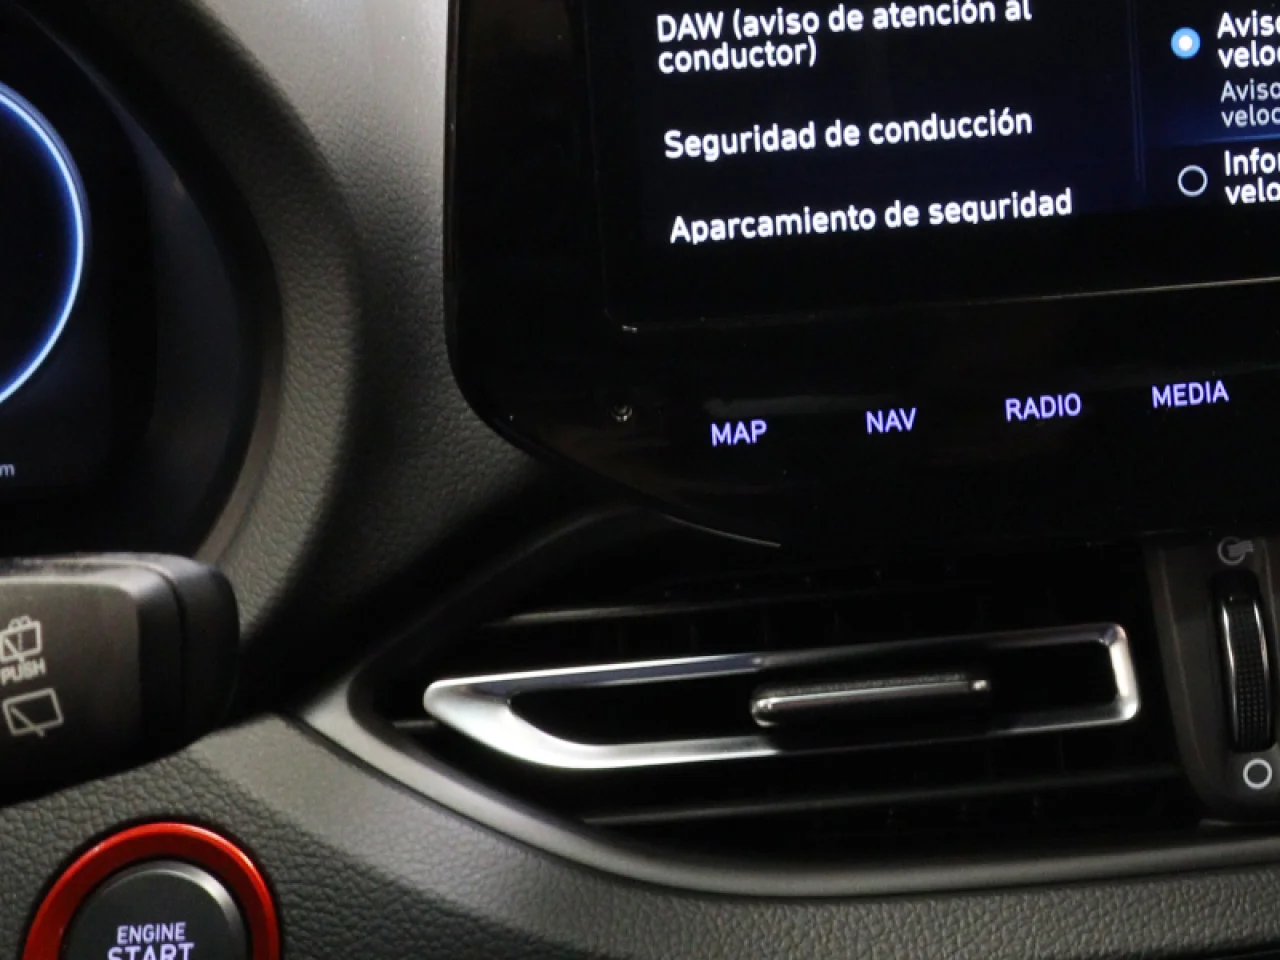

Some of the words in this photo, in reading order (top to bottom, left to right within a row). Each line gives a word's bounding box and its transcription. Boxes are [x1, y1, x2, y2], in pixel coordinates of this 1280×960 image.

[657, 11, 723, 41] DAW
[733, 8, 819, 39] (aviso
[828, 4, 863, 31] de
[658, 35, 816, 73] conductor)
[664, 122, 815, 162] Seguridad
[825, 119, 859, 147] de
[869, 108, 1032, 145] conducción
[670, 205, 876, 244] Aparcamiento
[885, 201, 919, 227] de
[929, 187, 1072, 224] seguridad
[1005, 393, 1082, 421] RADIO
[1152, 380, 1229, 409] MEDIA
[710, 420, 767, 446] MAP
[866, 407, 917, 433] NAV
[1, 656, 46, 685] PUSH
[117, 922, 187, 944] ENGINE
